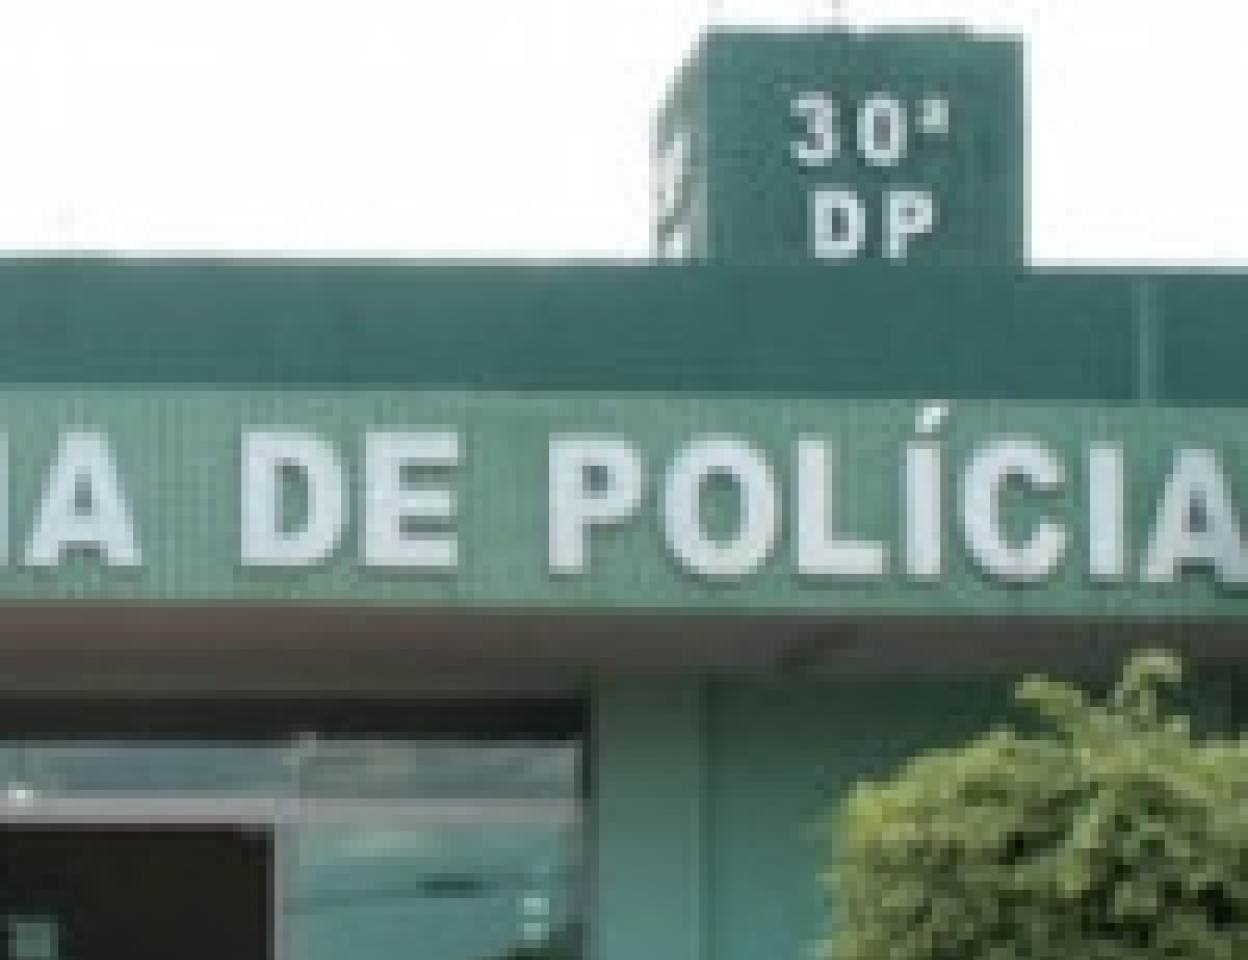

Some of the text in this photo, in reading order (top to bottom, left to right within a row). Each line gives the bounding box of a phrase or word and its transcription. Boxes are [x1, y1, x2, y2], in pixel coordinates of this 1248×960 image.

[810, 187, 940, 261] DP
[239, 425, 462, 568] DE
[548, 406, 1248, 584] POLÍCIA
